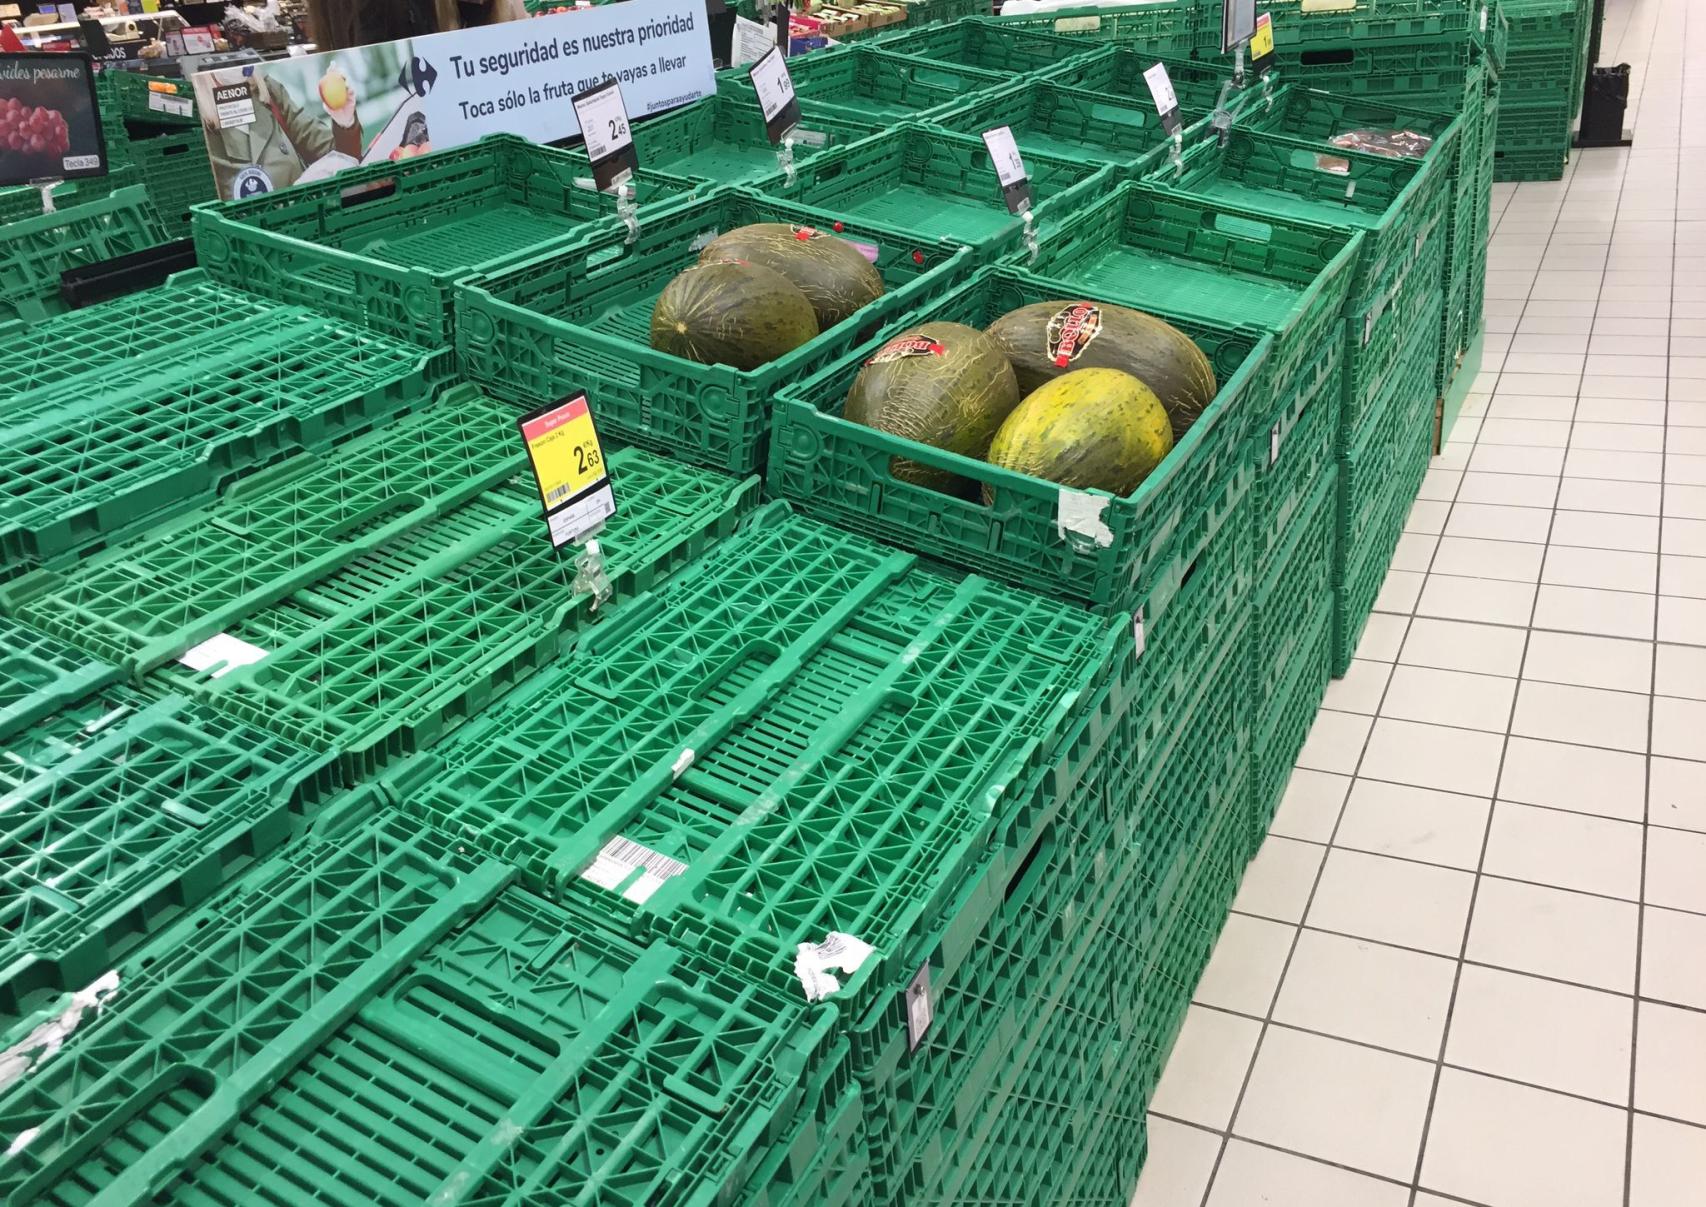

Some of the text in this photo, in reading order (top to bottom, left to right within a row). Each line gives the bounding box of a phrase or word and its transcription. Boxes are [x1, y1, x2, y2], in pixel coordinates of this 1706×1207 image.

[450, 12, 694, 79] Tu seguridad es nuestra prioridad
[33, 66, 80, 85] pesarme
[216, 86, 248, 101] AENOR
[459, 100, 495, 120] Toca
[498, 88, 526, 111] sólo
[528, 86, 540, 104] la
[543, 82, 574, 100] fruta
[577, 76, 599, 93] que
[616, 65, 648, 84] vayas
[650, 63, 657, 75] a
[659, 54, 687, 73] llevar
[646, 89, 702, 111] #juntosparaayudarte
[608, 119, 618, 141] 2
[618, 123, 626, 135] 45
[574, 445, 588, 475] 2
[587, 449, 600, 467] 63
